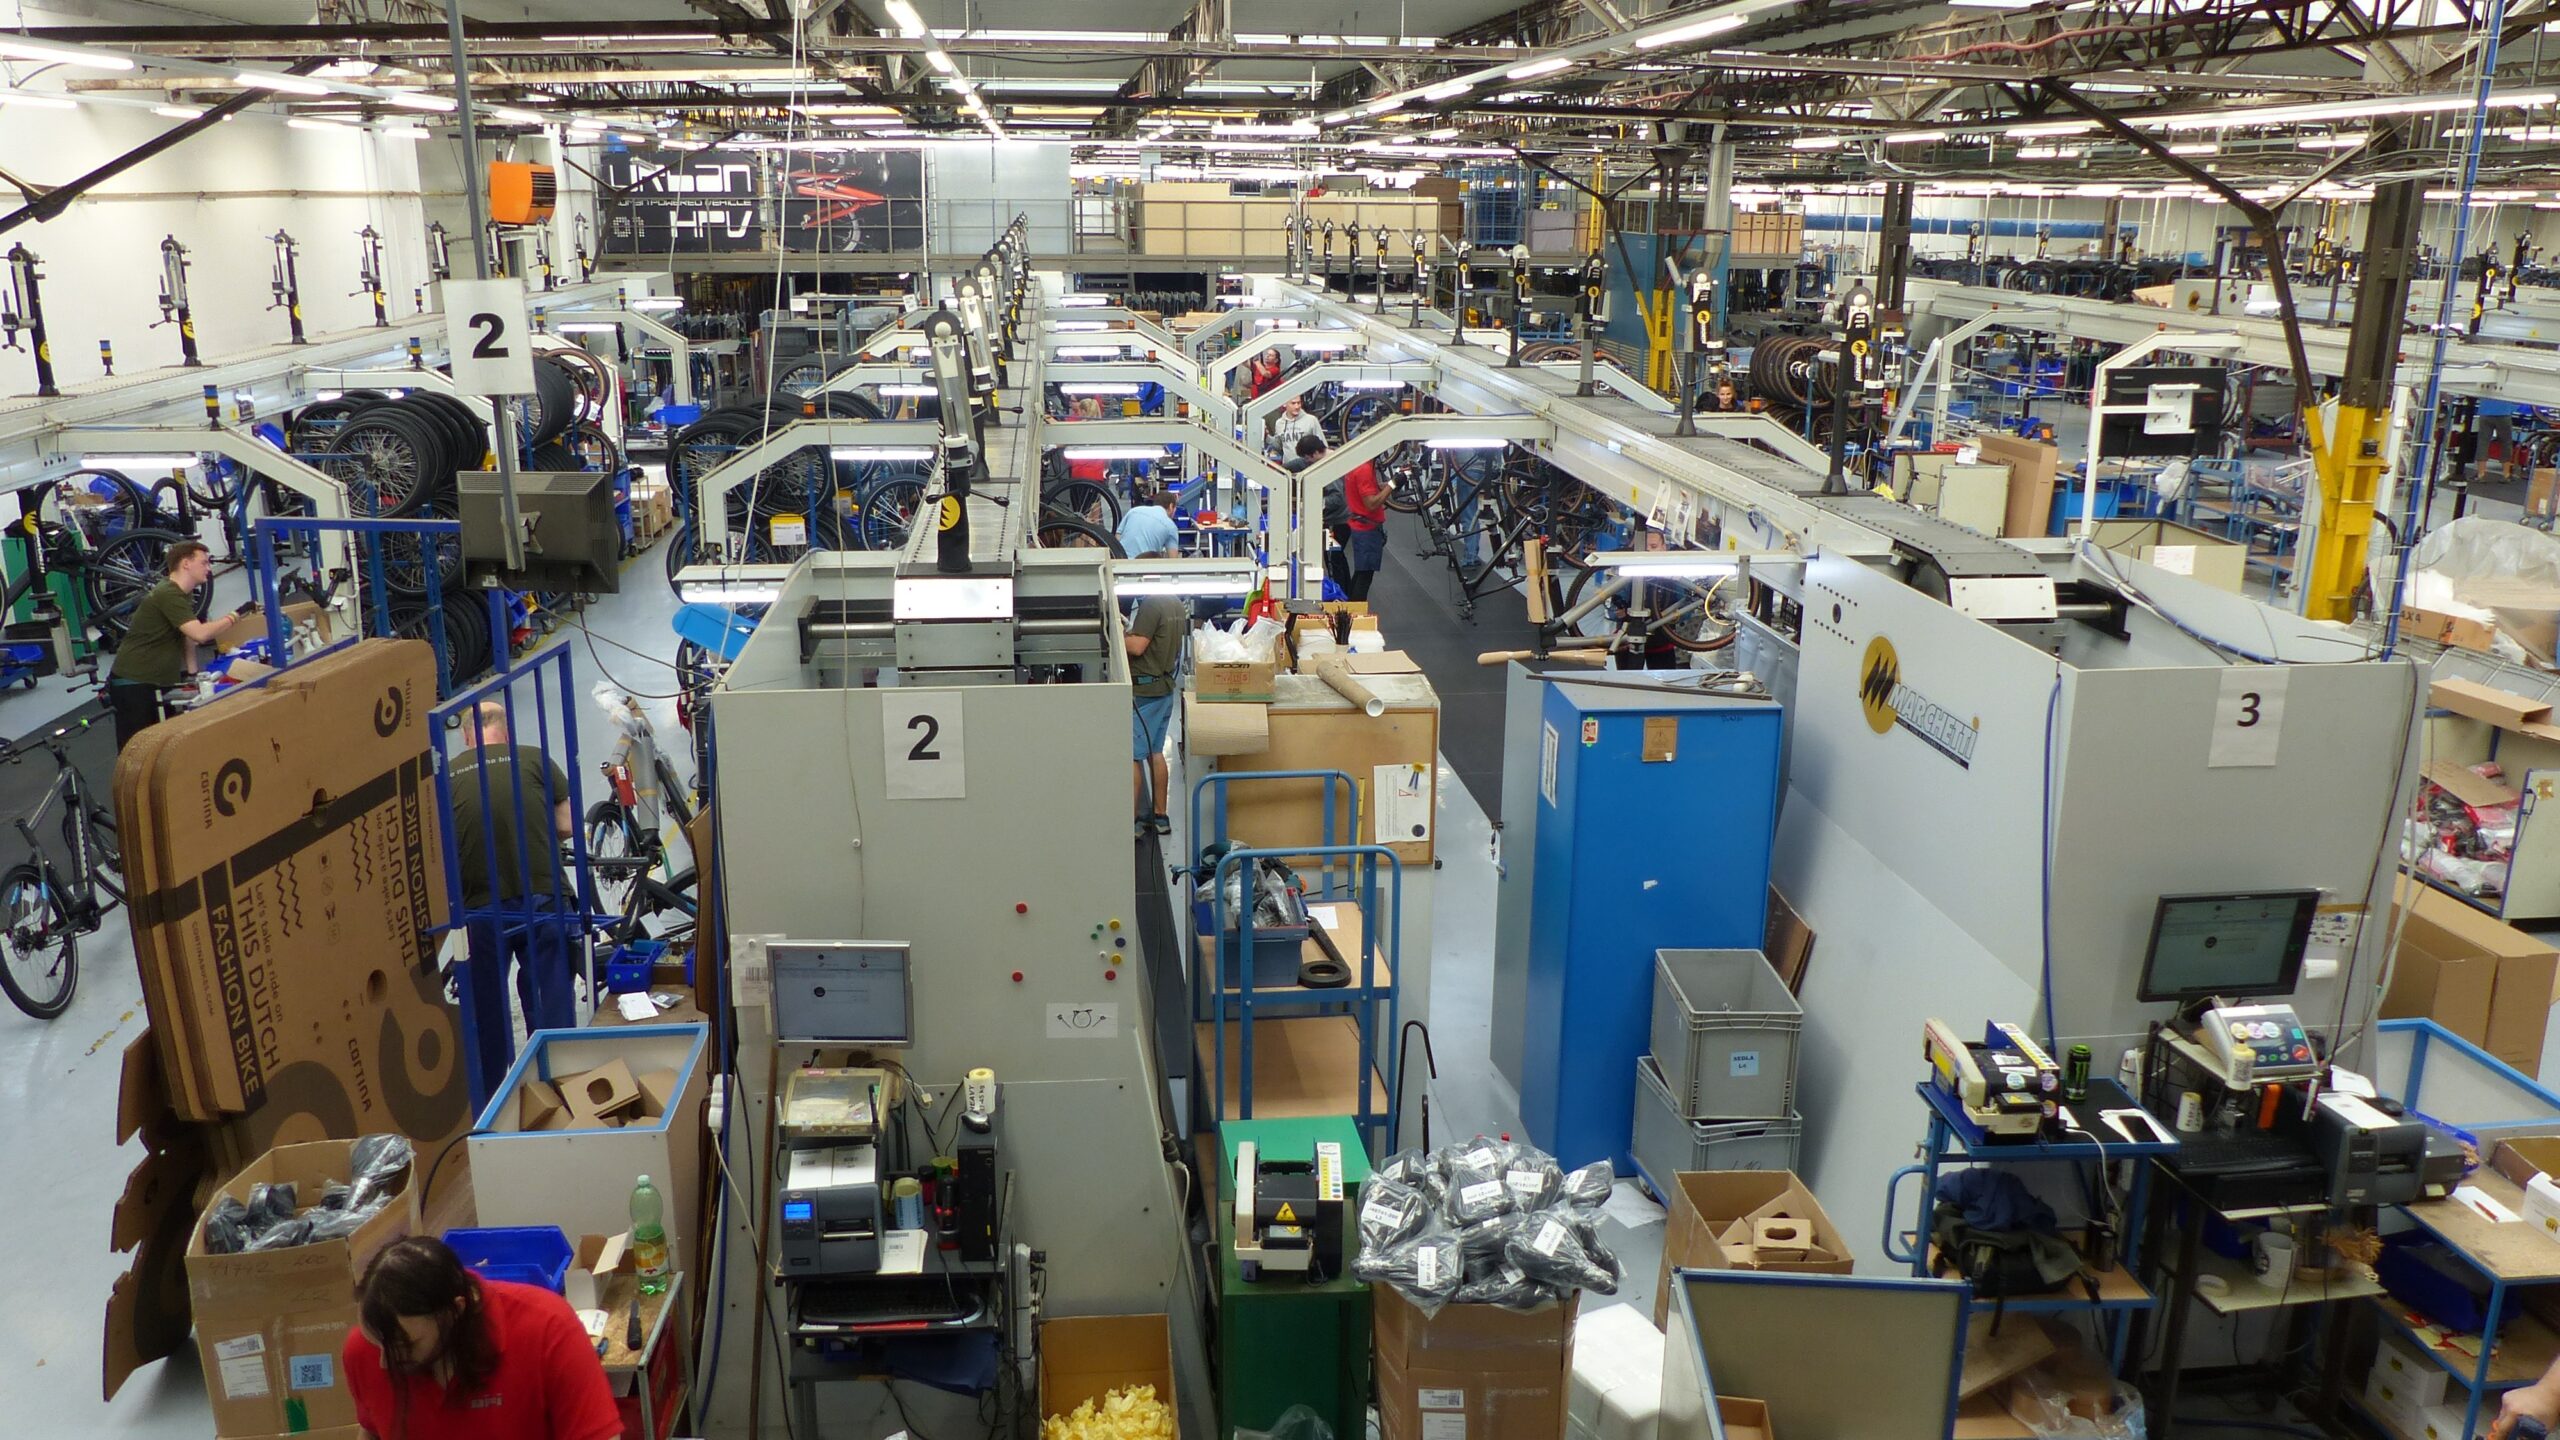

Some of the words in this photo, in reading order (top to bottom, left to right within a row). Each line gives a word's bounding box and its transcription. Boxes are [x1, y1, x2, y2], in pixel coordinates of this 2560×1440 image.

[469, 313, 509, 359] 2
[907, 714, 941, 761] 2
[1887, 681, 1978, 761] MARCHETTI
[2236, 692, 2261, 728] 3
[385, 804, 404, 899] DUTCH
[405, 791, 419, 848] BIKE
[260, 920, 271, 950] take
[269, 968, 281, 1000] ride
[275, 1003, 283, 1023] on
[396, 906, 414, 968] THIS
[212, 904, 247, 1030] FASHION
[235, 1032, 259, 1098] BIKE
[237, 887, 260, 958] THIS
[249, 965, 281, 1071] DUTCH
